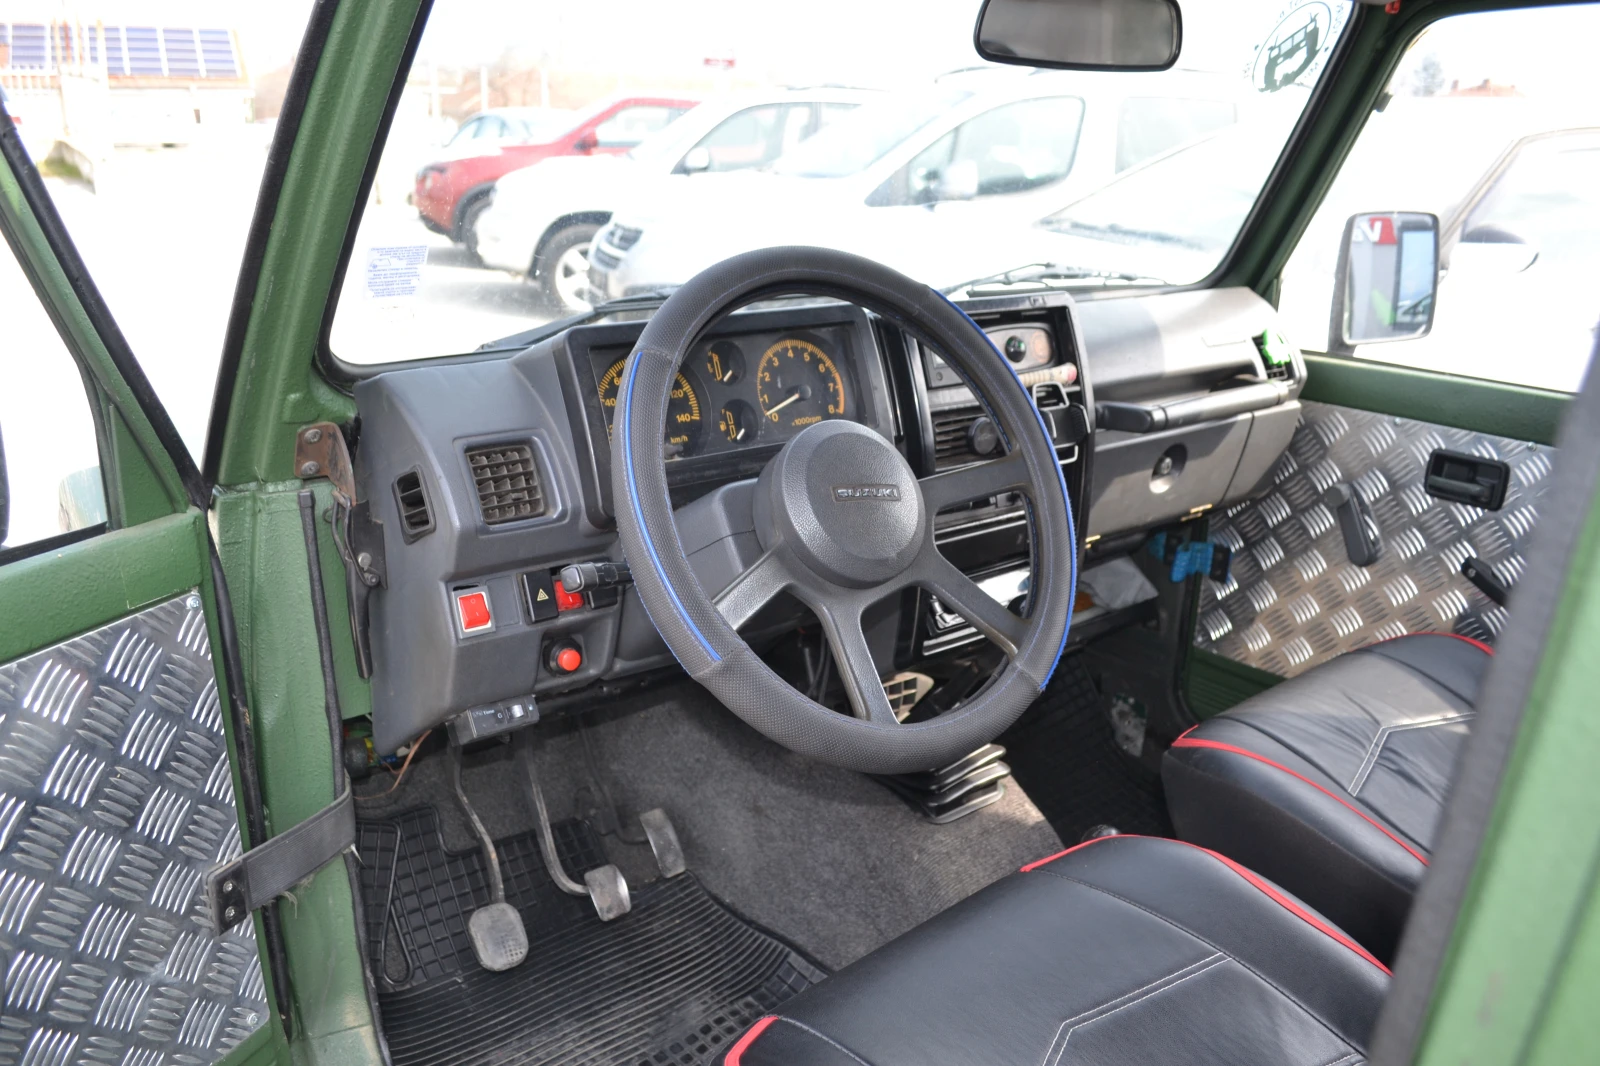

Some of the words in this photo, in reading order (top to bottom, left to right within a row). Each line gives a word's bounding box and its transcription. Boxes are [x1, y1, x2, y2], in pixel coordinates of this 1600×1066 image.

[787, 349, 794, 359] 4
[803, 352, 811, 362] 5
[772, 357, 779, 367] 3
[818, 363, 826, 373] 6
[763, 372, 771, 382] 2
[828, 383, 834, 392] 7
[604, 398, 616, 407] 40
[763, 394, 769, 404] 1
[828, 405, 835, 414] 8
[676, 413, 691, 423] 140
[771, 413, 779, 422] 0
[670, 435, 688, 444] km/h
[837, 488, 898, 498] SUZUKI
